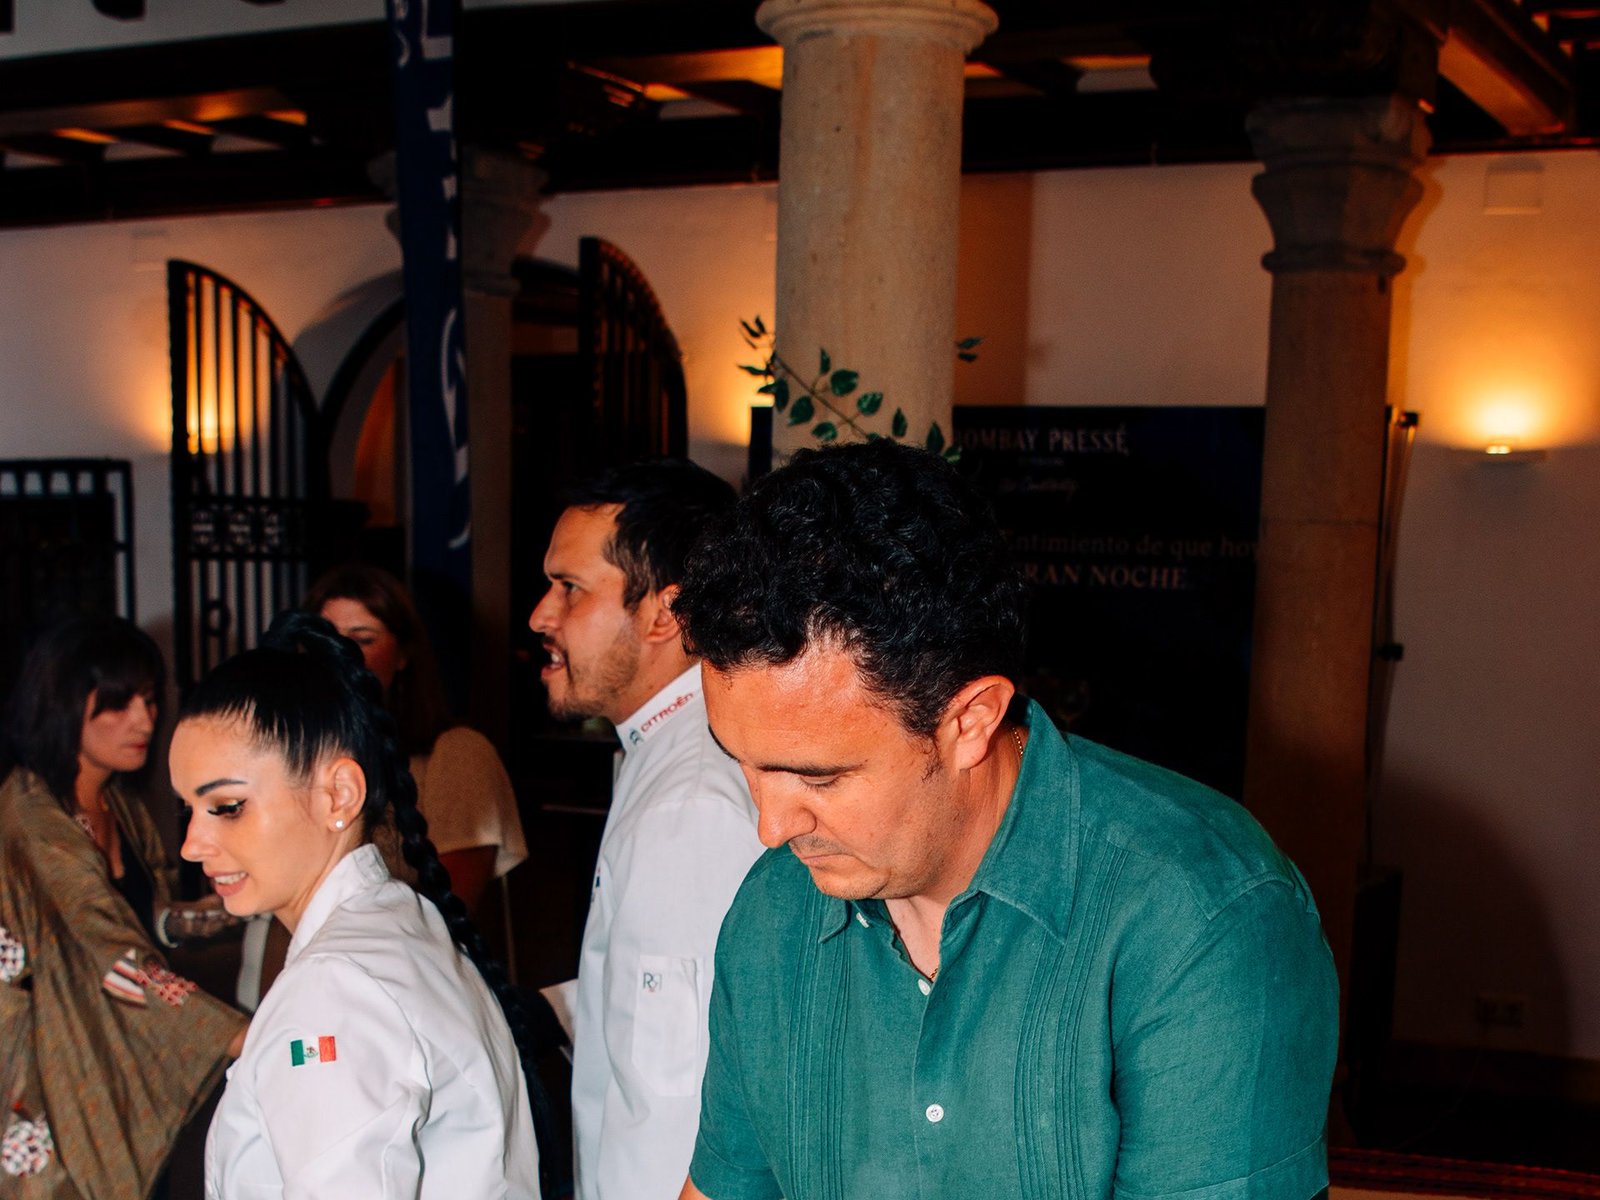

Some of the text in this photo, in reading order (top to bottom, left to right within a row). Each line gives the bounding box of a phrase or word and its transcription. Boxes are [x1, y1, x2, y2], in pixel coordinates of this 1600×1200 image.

[1136, 533, 1163, 556] de
[1170, 539, 1212, 562] que
[1022, 561, 1189, 590] RAN NOCHE
